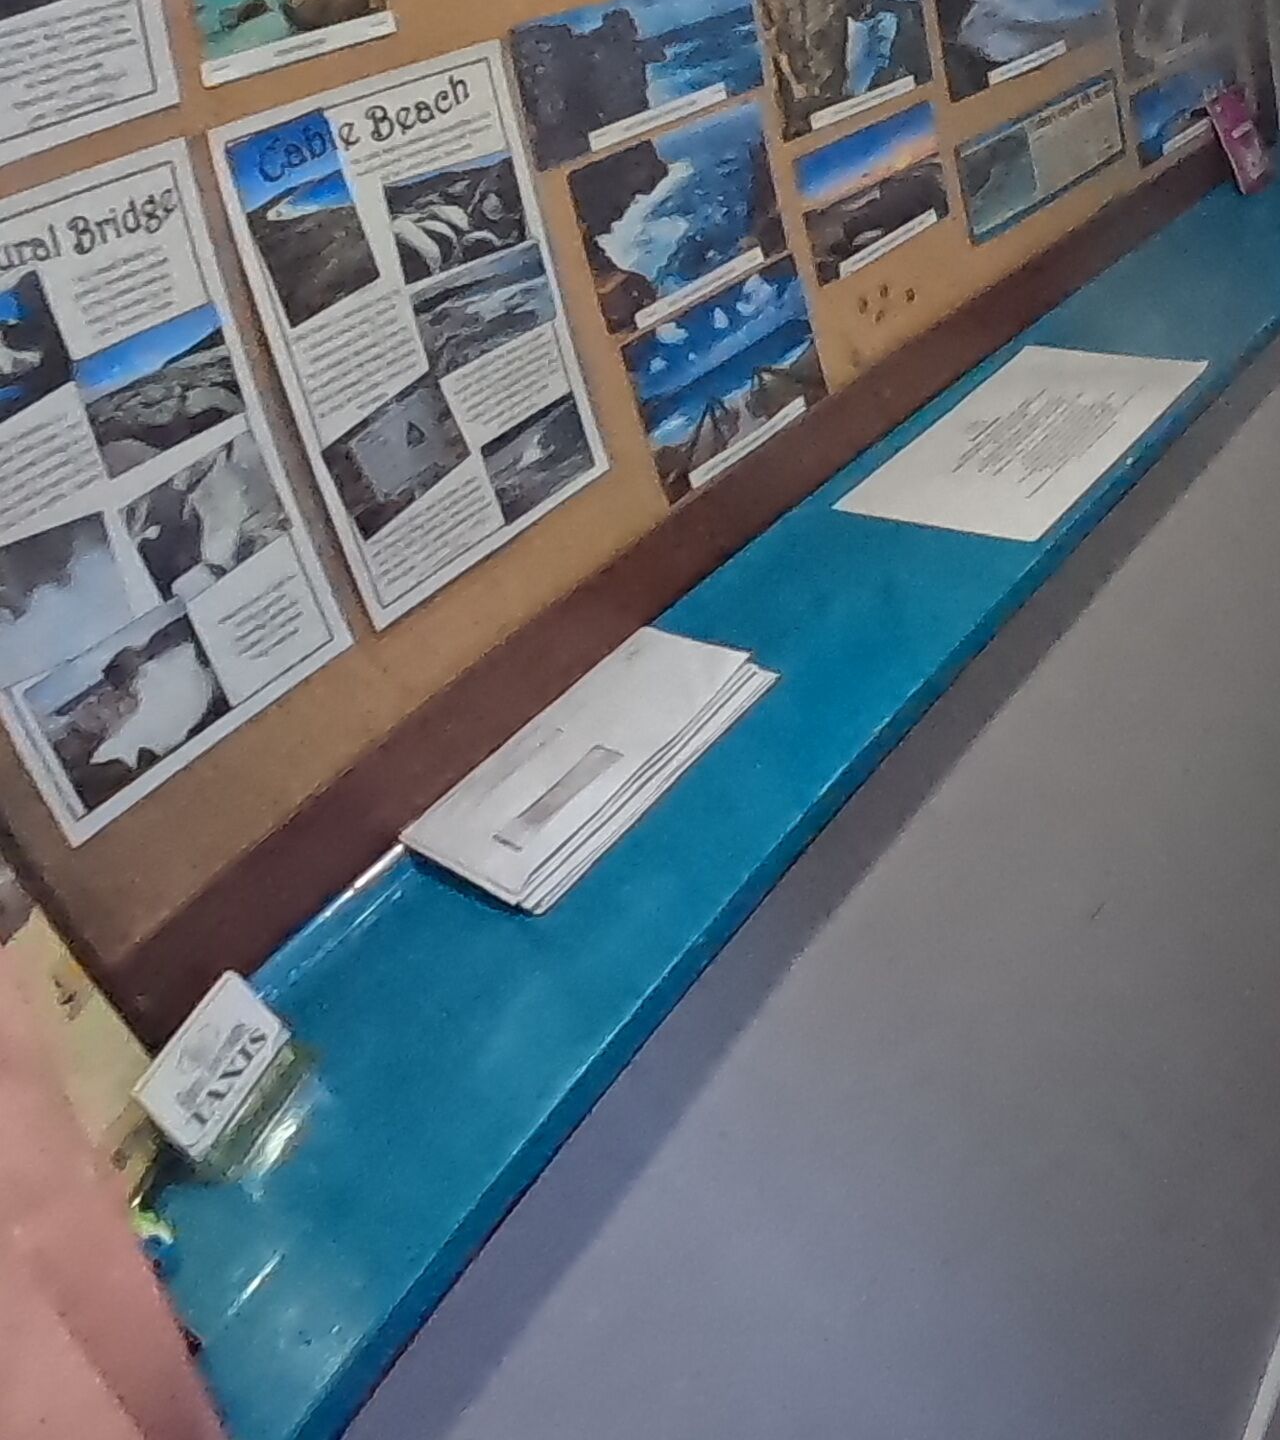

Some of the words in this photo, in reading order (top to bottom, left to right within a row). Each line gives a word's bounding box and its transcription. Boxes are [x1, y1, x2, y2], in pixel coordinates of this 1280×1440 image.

[257, 116, 361, 183] Cable
[365, 74, 470, 143] Beach
[66, 187, 178, 256] Bridge
